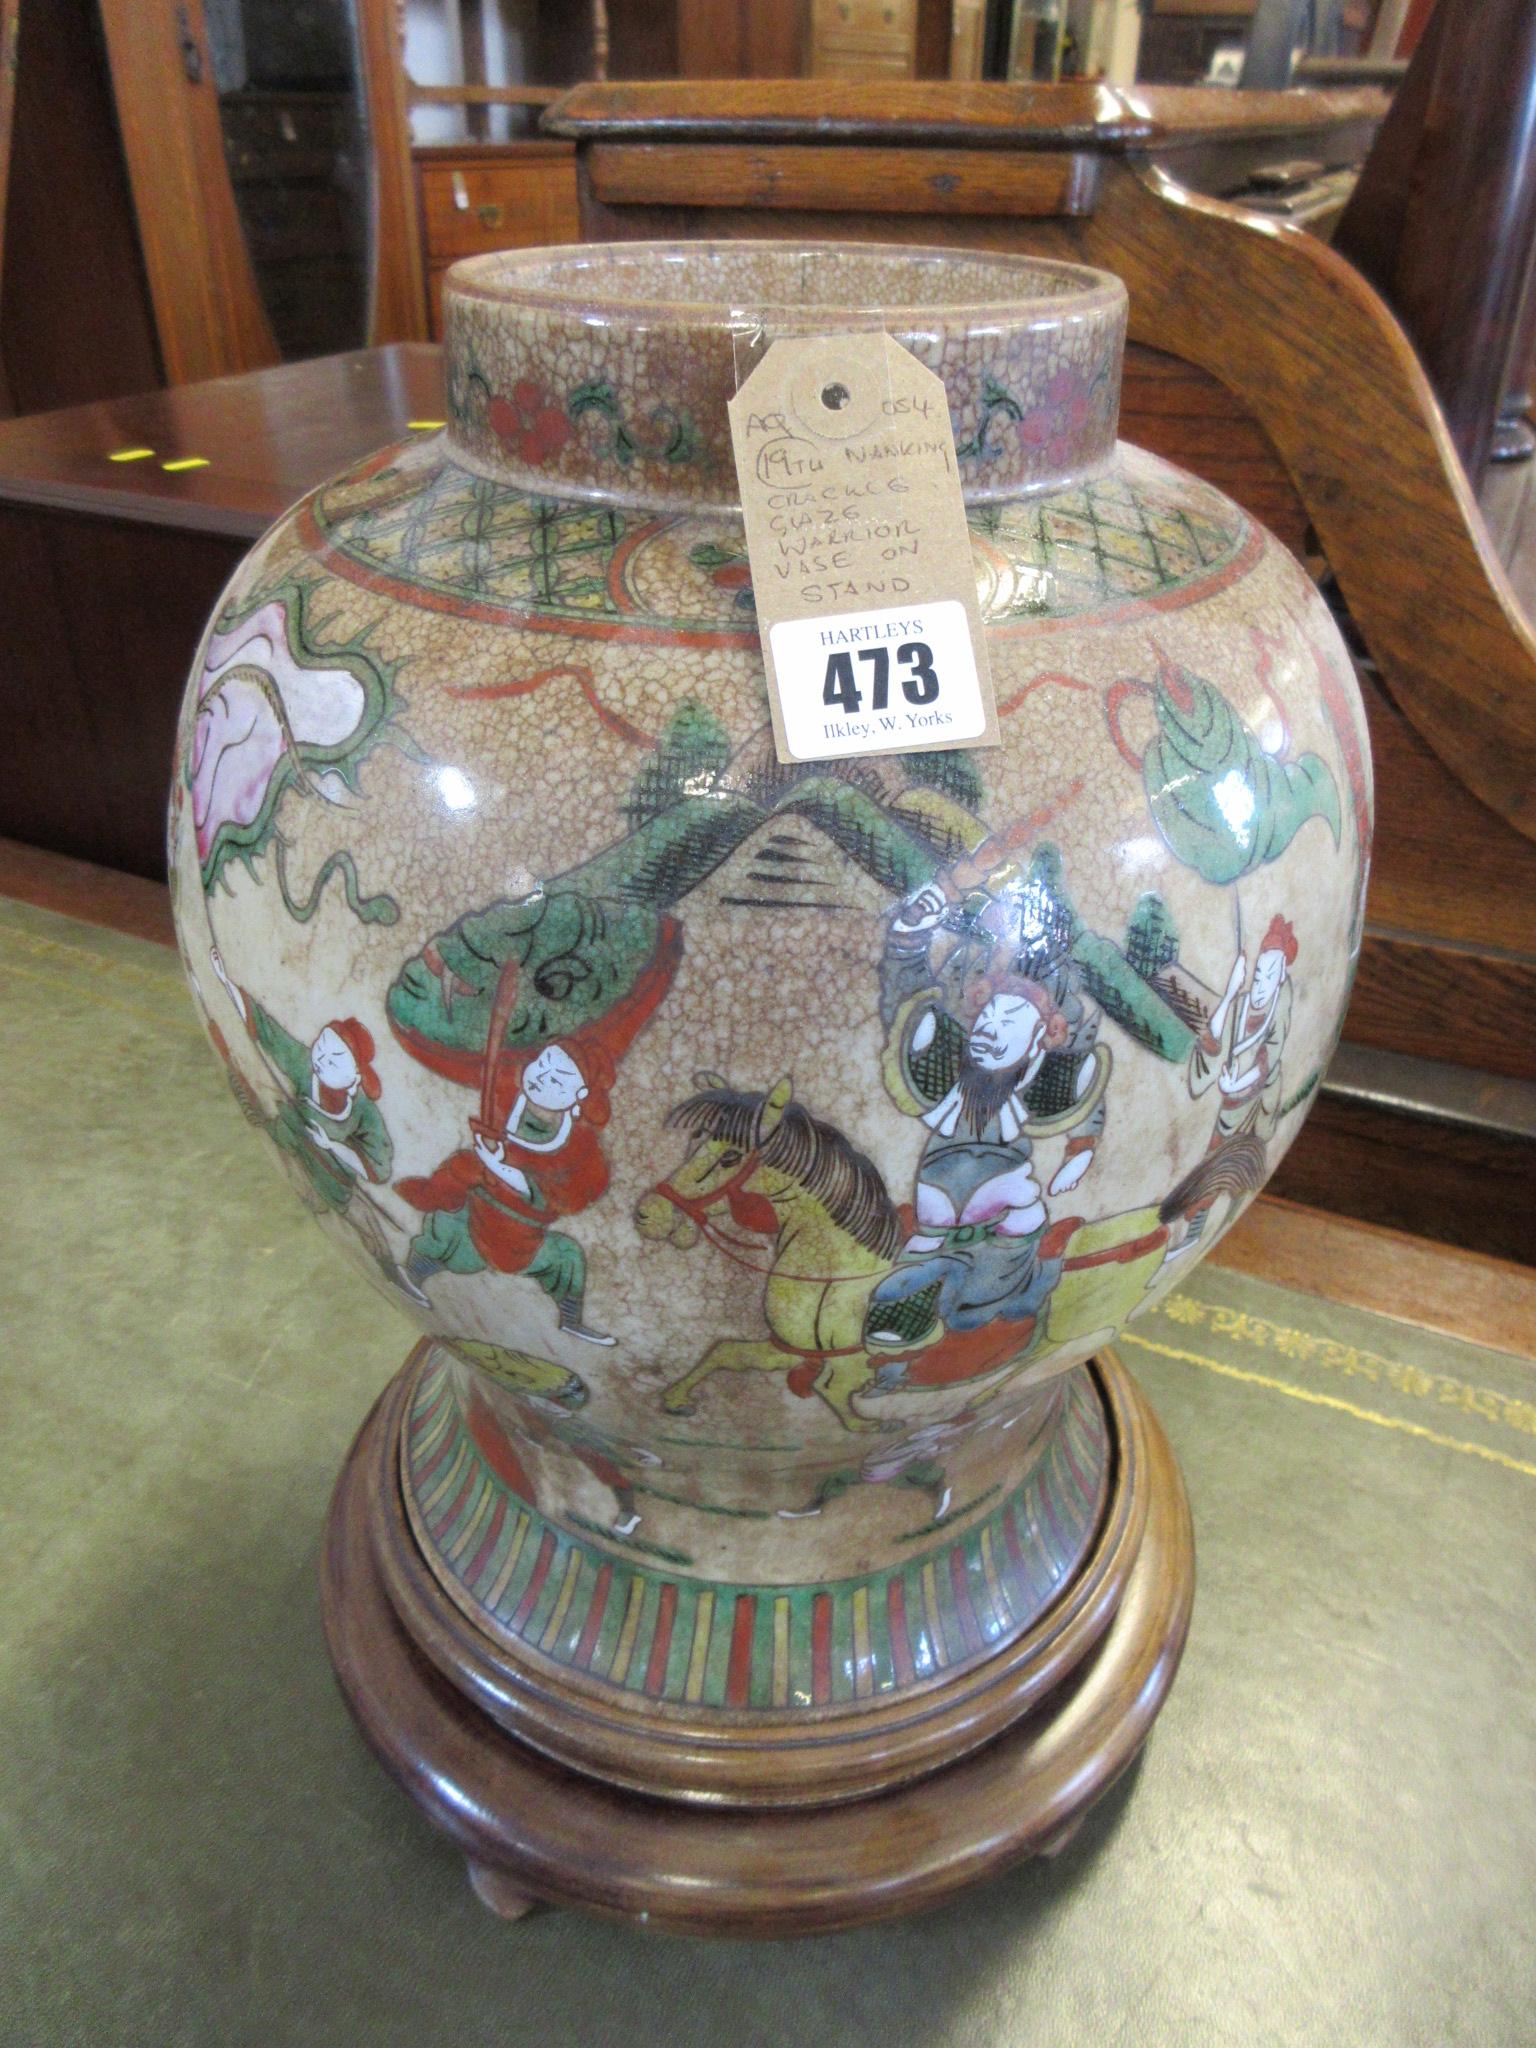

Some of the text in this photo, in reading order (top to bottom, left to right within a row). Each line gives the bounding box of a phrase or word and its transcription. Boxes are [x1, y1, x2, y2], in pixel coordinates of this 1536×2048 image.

[778, 520, 920, 556] WARRIOR
[774, 540, 918, 579] VASE ON
[801, 578, 911, 602] STAND
[820, 619, 923, 645] HARTLEYS
[822, 642, 940, 714] 473
[879, 714, 902, 730] W.
[905, 710, 953, 729] Yorks
